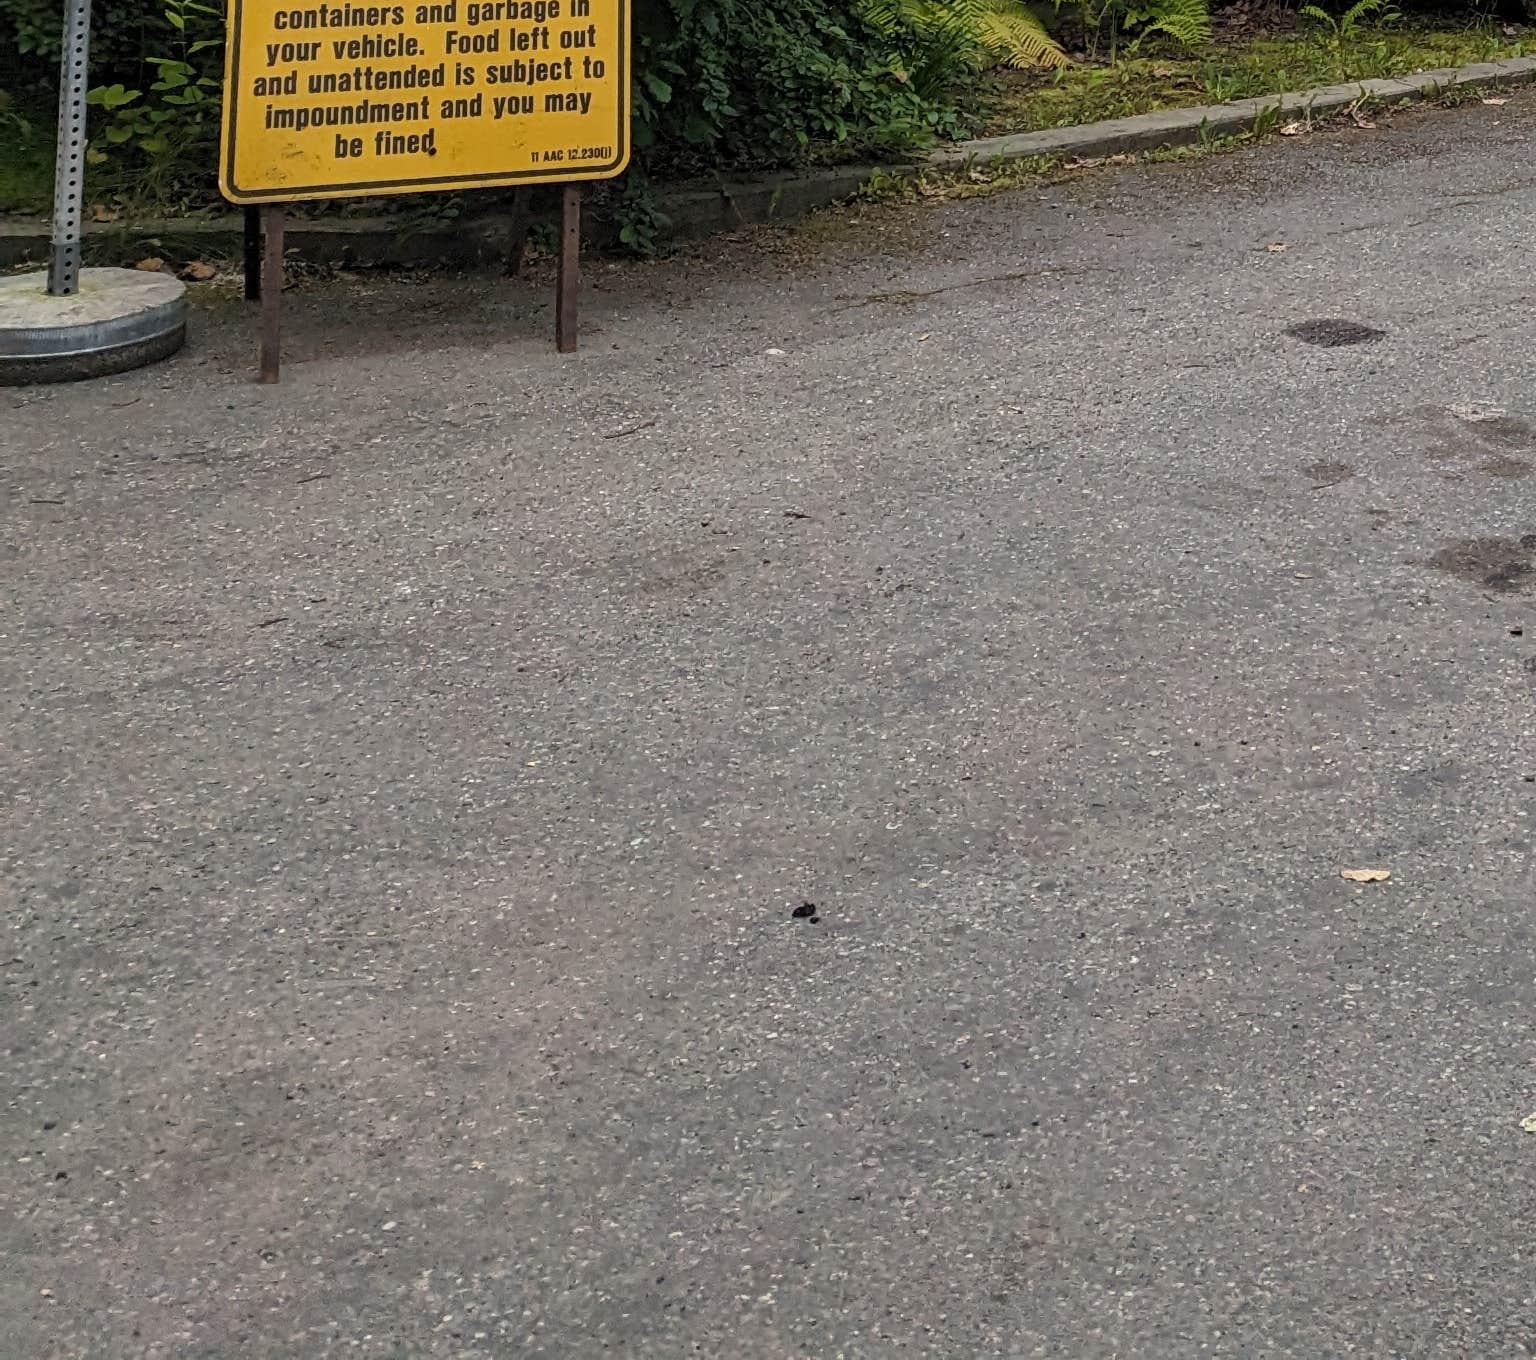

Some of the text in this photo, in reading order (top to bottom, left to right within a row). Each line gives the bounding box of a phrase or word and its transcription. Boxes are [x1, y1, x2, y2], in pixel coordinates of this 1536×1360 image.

[273, 3, 405, 30] containers
[414, 0, 457, 25] and
[266, 24, 597, 68] your vehicle. Food left out
[252, 55, 606, 97] and unattended is subject to
[264, 91, 593, 131] impoundment and you may
[334, 133, 363, 159] be
[530, 151, 539, 163] 11
[543, 149, 564, 162] AAC
